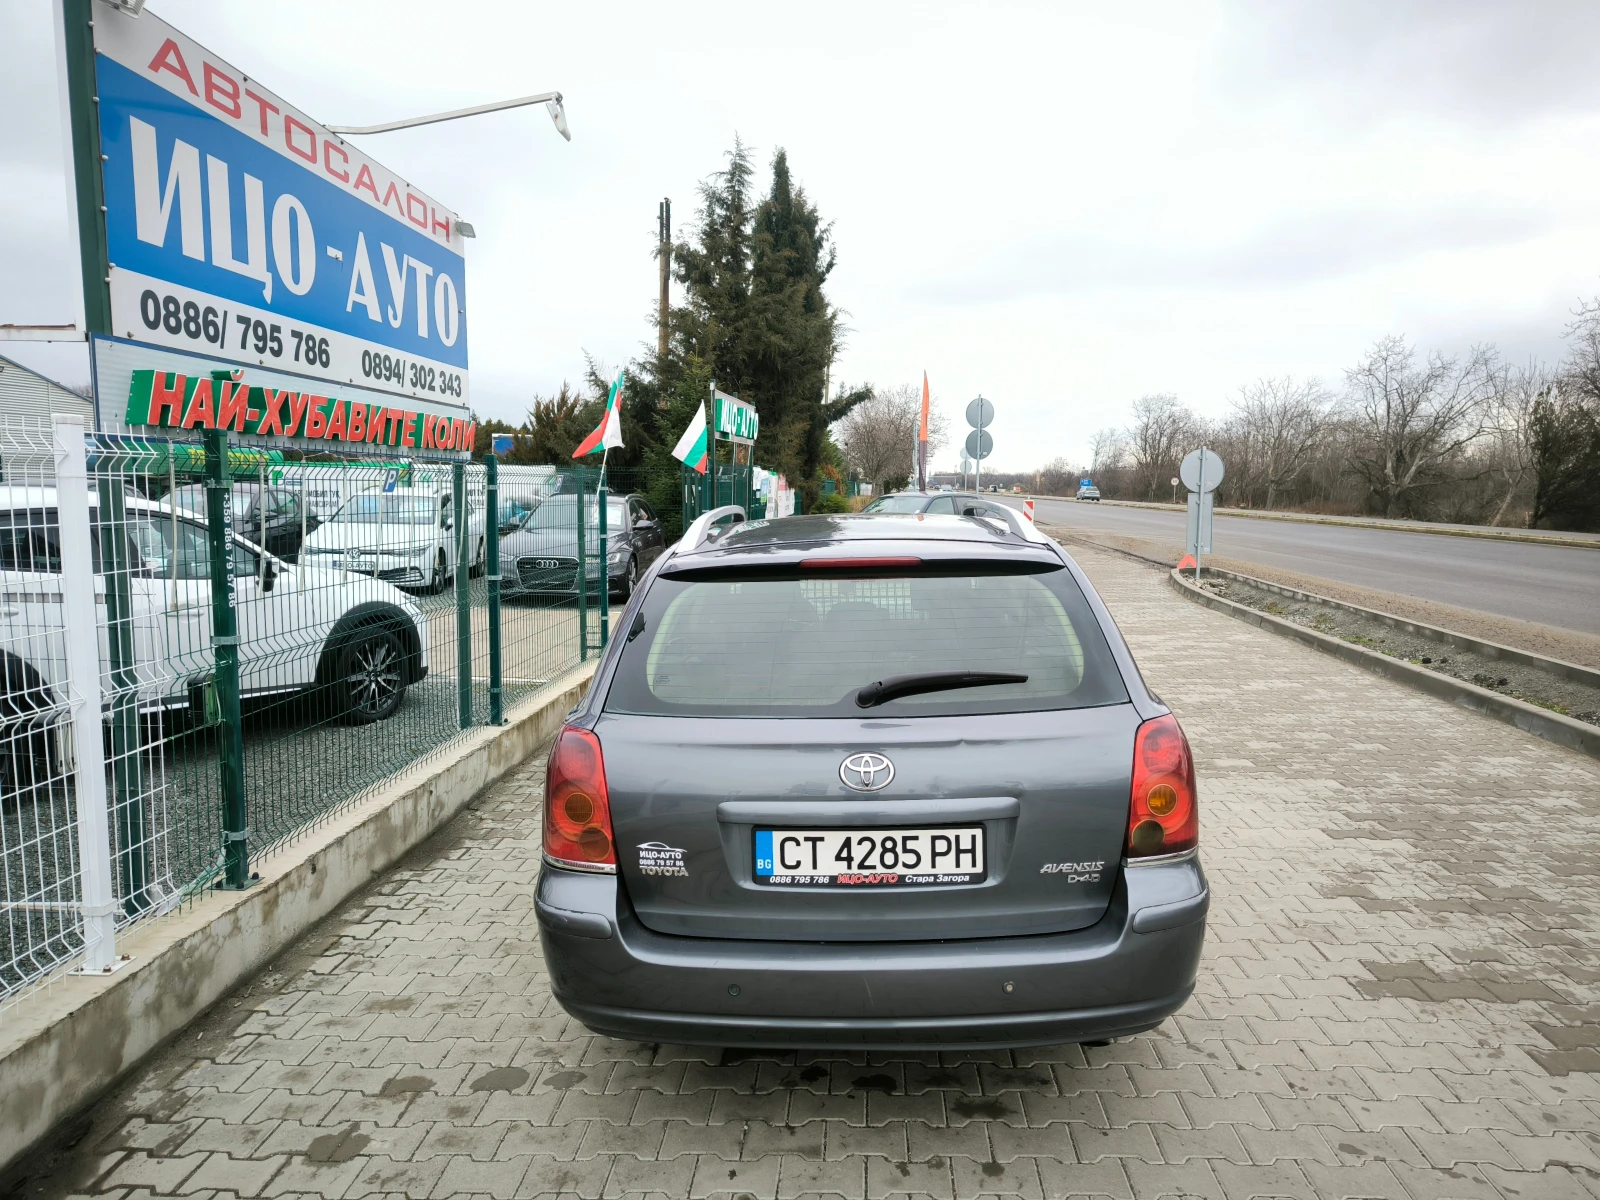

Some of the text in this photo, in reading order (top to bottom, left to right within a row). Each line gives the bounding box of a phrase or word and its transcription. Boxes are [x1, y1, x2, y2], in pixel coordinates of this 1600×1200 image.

[148, 38, 450, 243] АВТОСАЛОН
[140, 290, 330, 369] 0886/ 795 786
[362, 350, 462, 398] 0894/ 302 343
[147, 369, 477, 453] НАЙ-ХУБАВИТЕ КОЛИ
[224, 527, 233, 551] 886
[226, 554, 234, 570] 79
[228, 592, 236, 608] 86
[639, 850, 682, 859] ИЦО-АУТО
[757, 858, 772, 869] BG
[834, 836, 922, 870] 4285
[639, 866, 689, 877] TOYOTA
[1040, 861, 1105, 873] AVENSIS
[769, 873, 970, 884] 0886 795 786 ИЦО-АУТО Стара Загора
[1067, 873, 1101, 884] D-4D
